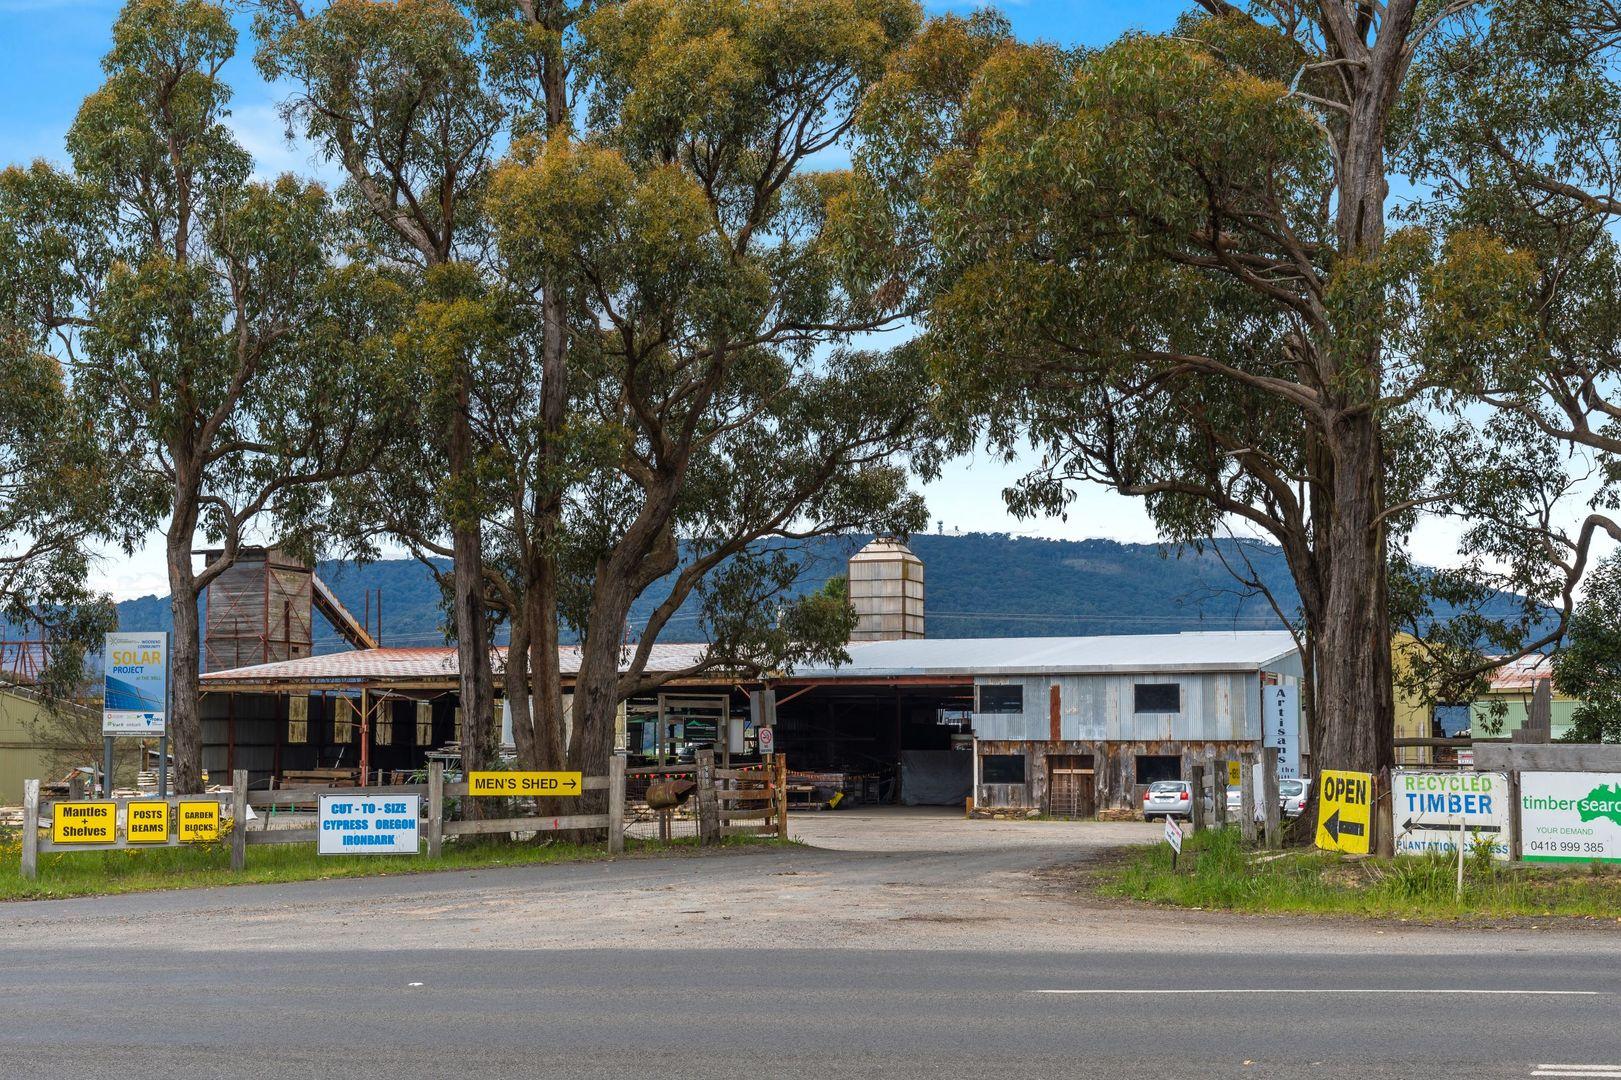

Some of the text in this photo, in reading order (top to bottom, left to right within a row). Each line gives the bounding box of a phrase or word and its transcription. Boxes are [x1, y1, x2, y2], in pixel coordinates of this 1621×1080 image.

[112, 650, 161, 666] SOLAR
[112, 666, 144, 674] PROJECT
[1276, 688, 1286, 764] Artisans
[475, 778, 558, 789] MEN'S SHED
[1405, 776, 1492, 792] RECYCLED
[1324, 777, 1366, 805] OPEN
[331, 803, 353, 814] CUT
[361, 803, 376, 814] TO
[384, 802, 407, 814] SIZE
[1405, 793, 1493, 815] TIMBER
[63, 807, 107, 817] Mantles
[133, 810, 162, 819] POSTS
[184, 811, 214, 819] GARDEN
[131, 824, 164, 833] BEAMS
[184, 823, 213, 832] BLOCKS
[323, 819, 416, 830] CYPRESS OREGON
[63, 826, 107, 837] Shelves
[1536, 826, 1594, 836] YOUR DEMAND
[342, 834, 395, 846] IRONBARK
[1396, 840, 1509, 854] PLANTATION CYESS
[1530, 840, 1604, 854] 0418 999 385
